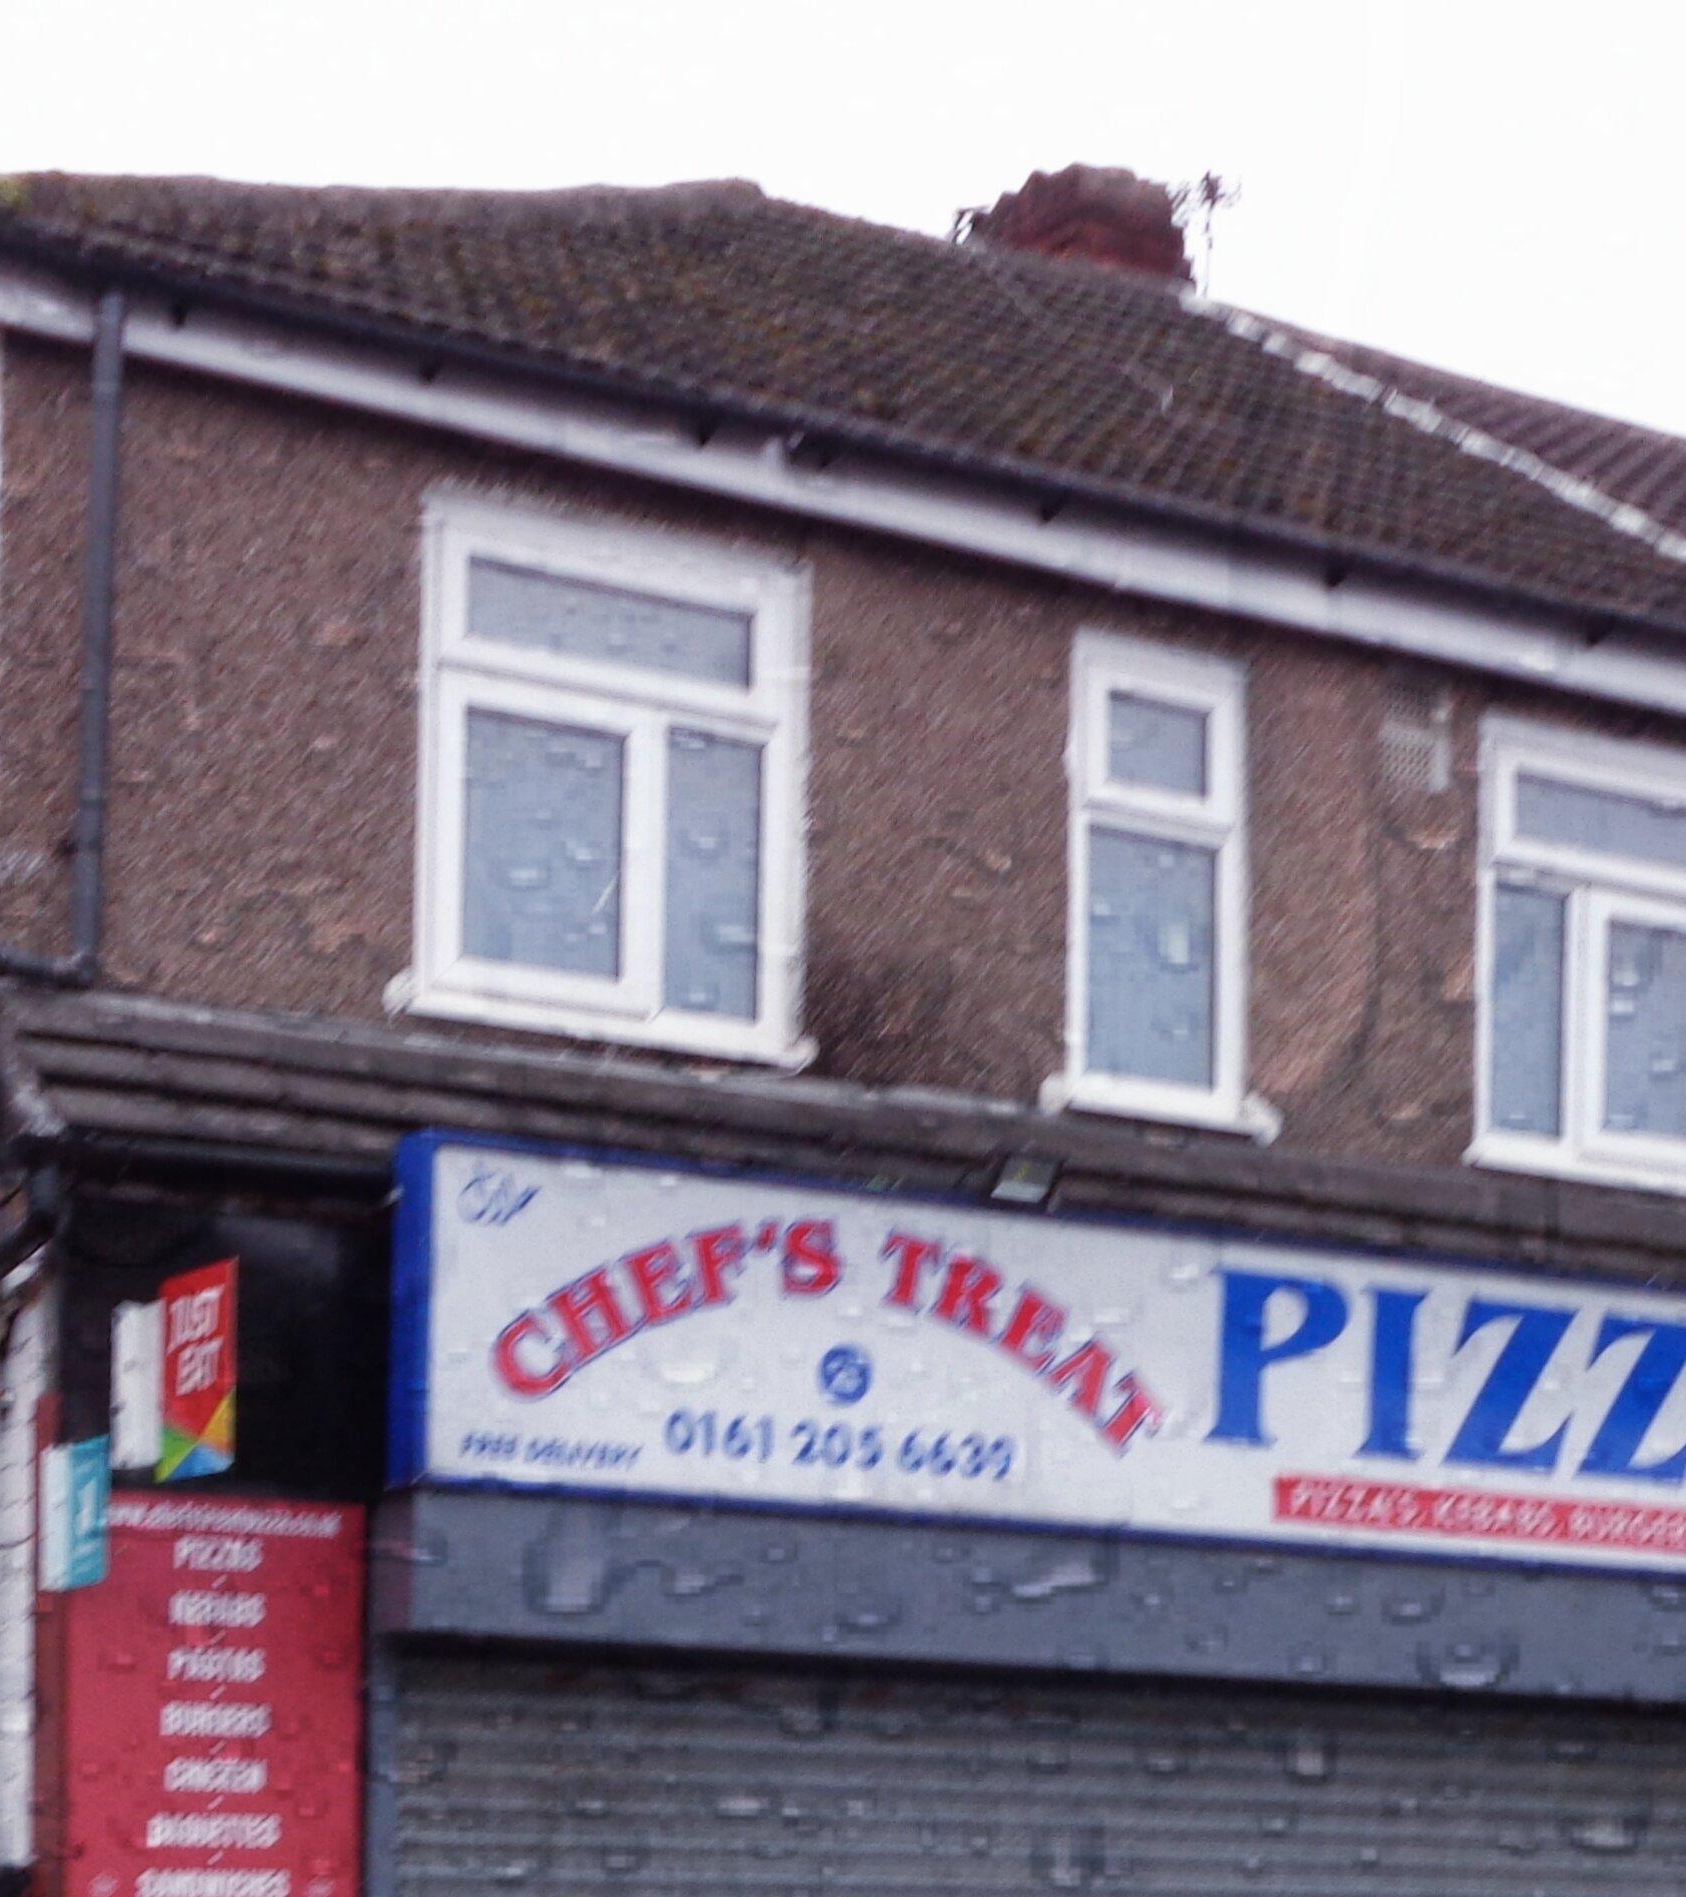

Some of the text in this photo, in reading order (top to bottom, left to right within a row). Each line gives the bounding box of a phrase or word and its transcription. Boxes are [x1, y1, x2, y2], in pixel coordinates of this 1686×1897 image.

[168, 1285, 225, 1354] JUST
[491, 1217, 1165, 1458] CHEF'S TREAT
[176, 1338, 224, 1397] EAT
[665, 1409, 775, 1464] 0161
[790, 1417, 883, 1471] 205
